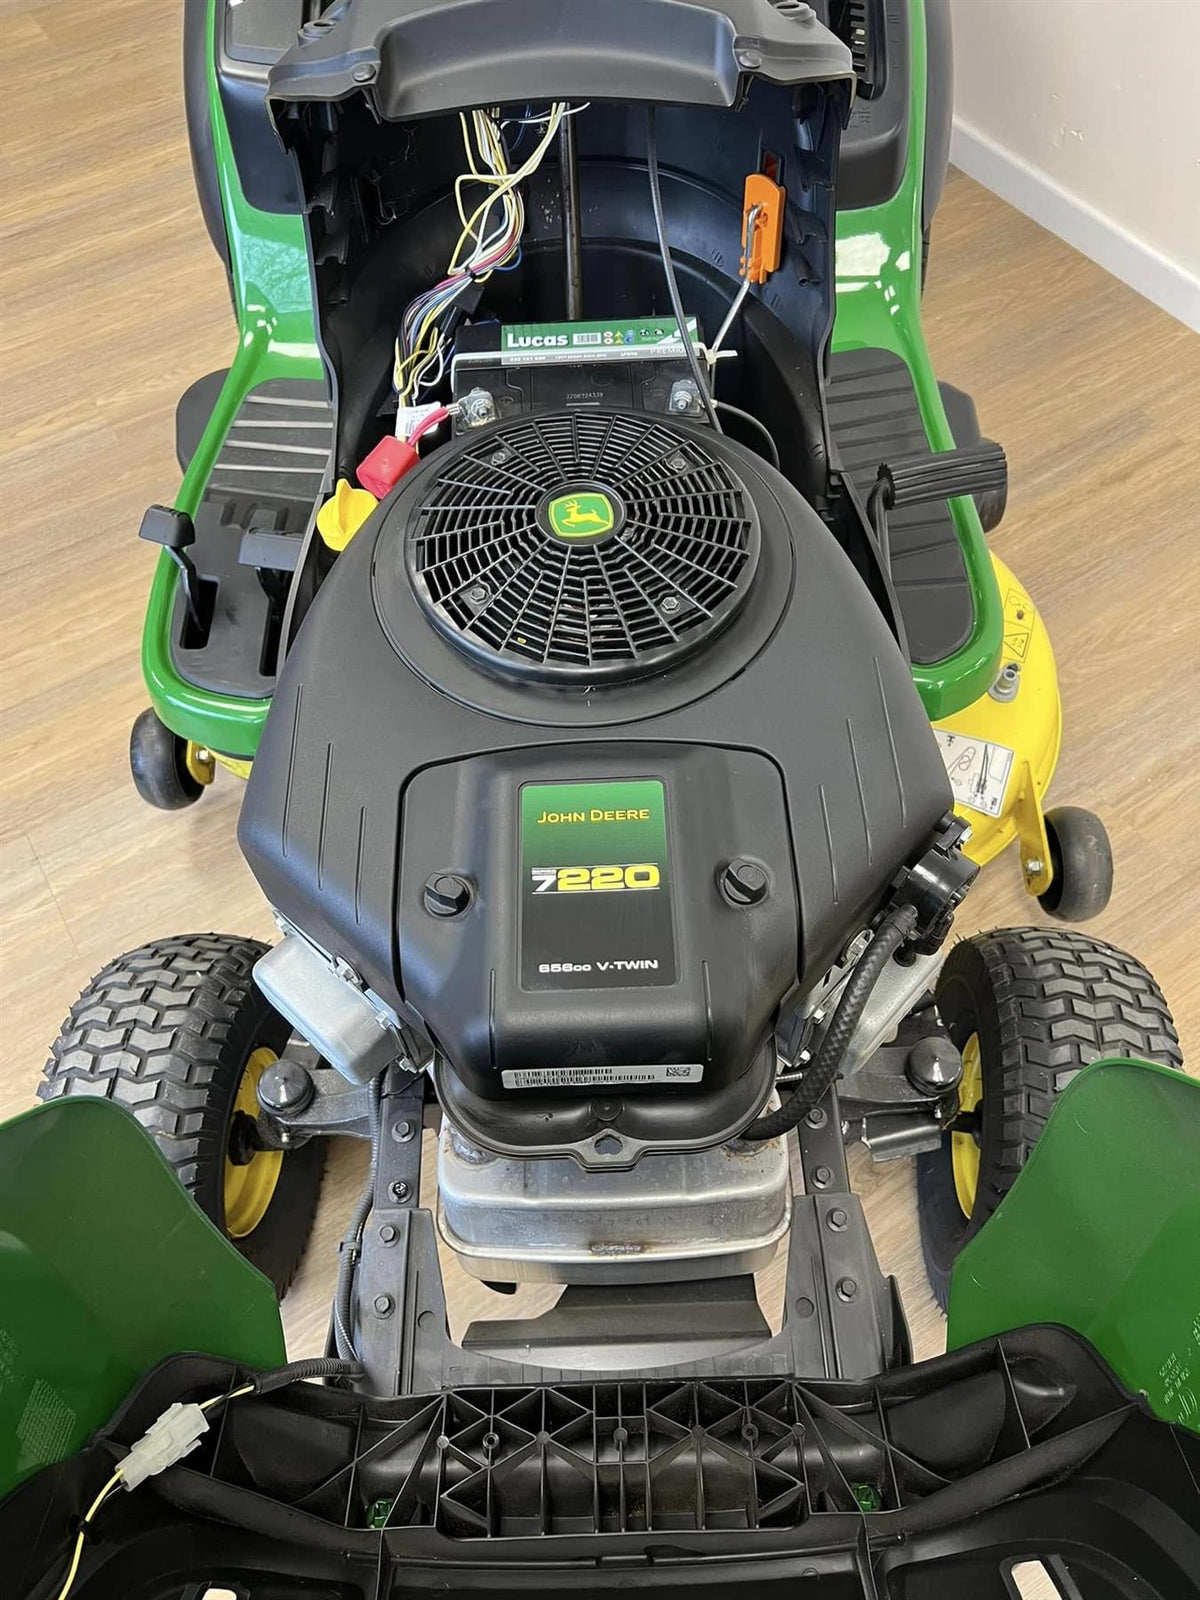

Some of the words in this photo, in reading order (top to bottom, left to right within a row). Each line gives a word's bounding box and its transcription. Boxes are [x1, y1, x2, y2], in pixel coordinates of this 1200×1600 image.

[506, 333, 569, 348] Lucas
[650, 346, 693, 356] PREMIU
[537, 811, 586, 824] JOHN
[590, 809, 650, 822] DEERE
[531, 865, 660, 892] 7220
[538, 963, 592, 973] 656cc
